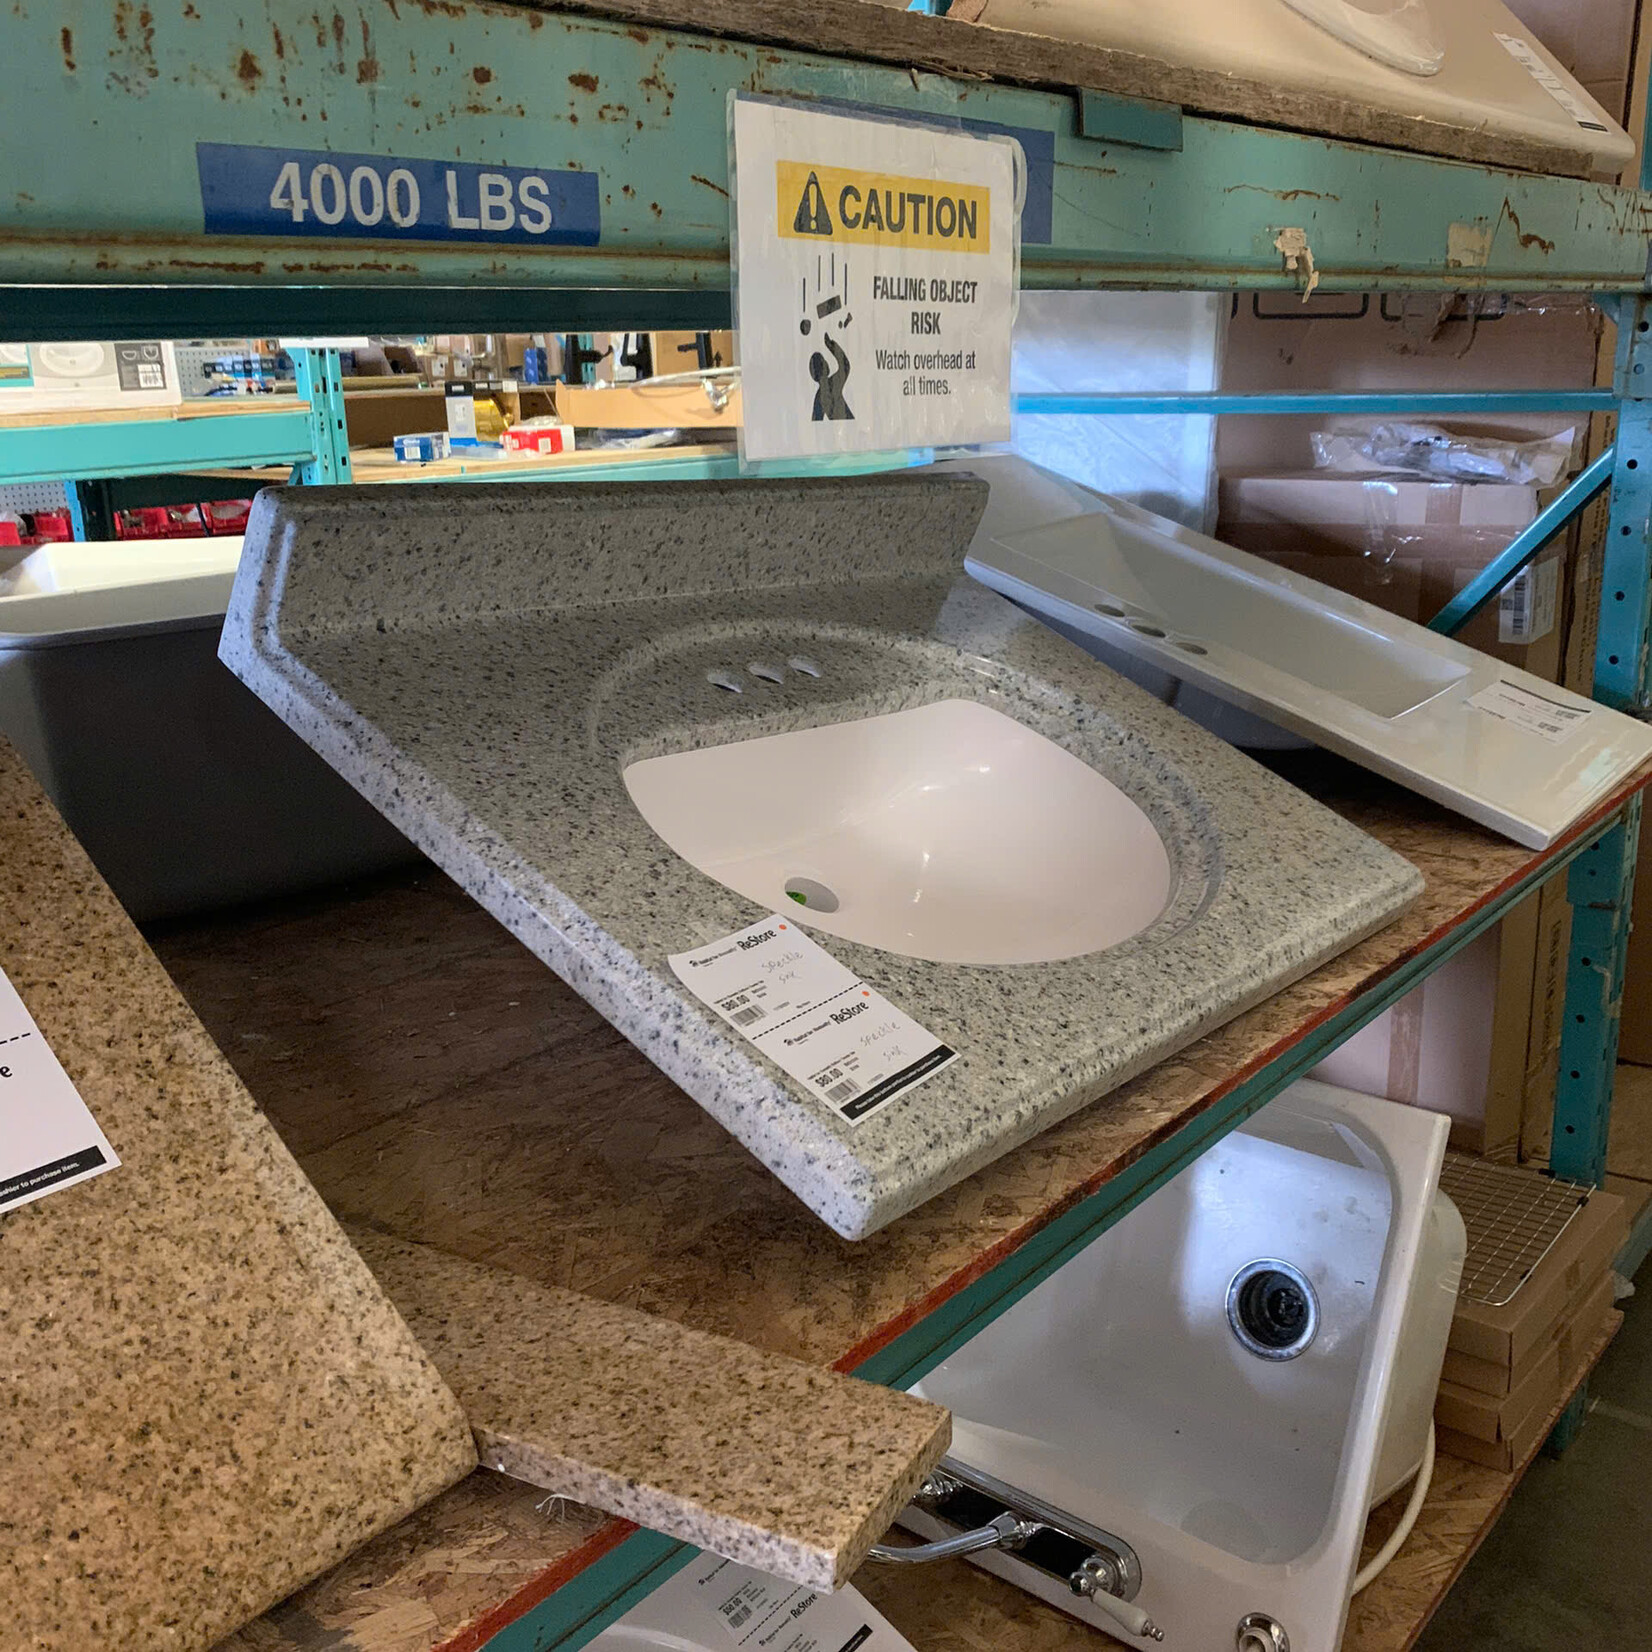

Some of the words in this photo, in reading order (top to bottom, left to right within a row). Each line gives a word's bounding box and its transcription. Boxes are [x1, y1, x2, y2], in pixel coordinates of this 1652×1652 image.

[269, 162, 421, 228] 4000
[446, 169, 553, 234] LBS
[838, 184, 977, 239] CAUTION
[873, 275, 927, 302] FALLING
[930, 280, 978, 304] OBJECT
[911, 311, 941, 335] RISK
[876, 350, 911, 370] Watch
[914, 349, 963, 370] overhead
[965, 351, 976, 370] at
[903, 376, 917, 396] all
[919, 375, 952, 396] times.
[736, 929, 777, 951] ReStore
[829, 1001, 869, 1024] ReStore
[30, 1168, 62, 1186] purchase
[790, 1593, 817, 1619] ReStore
